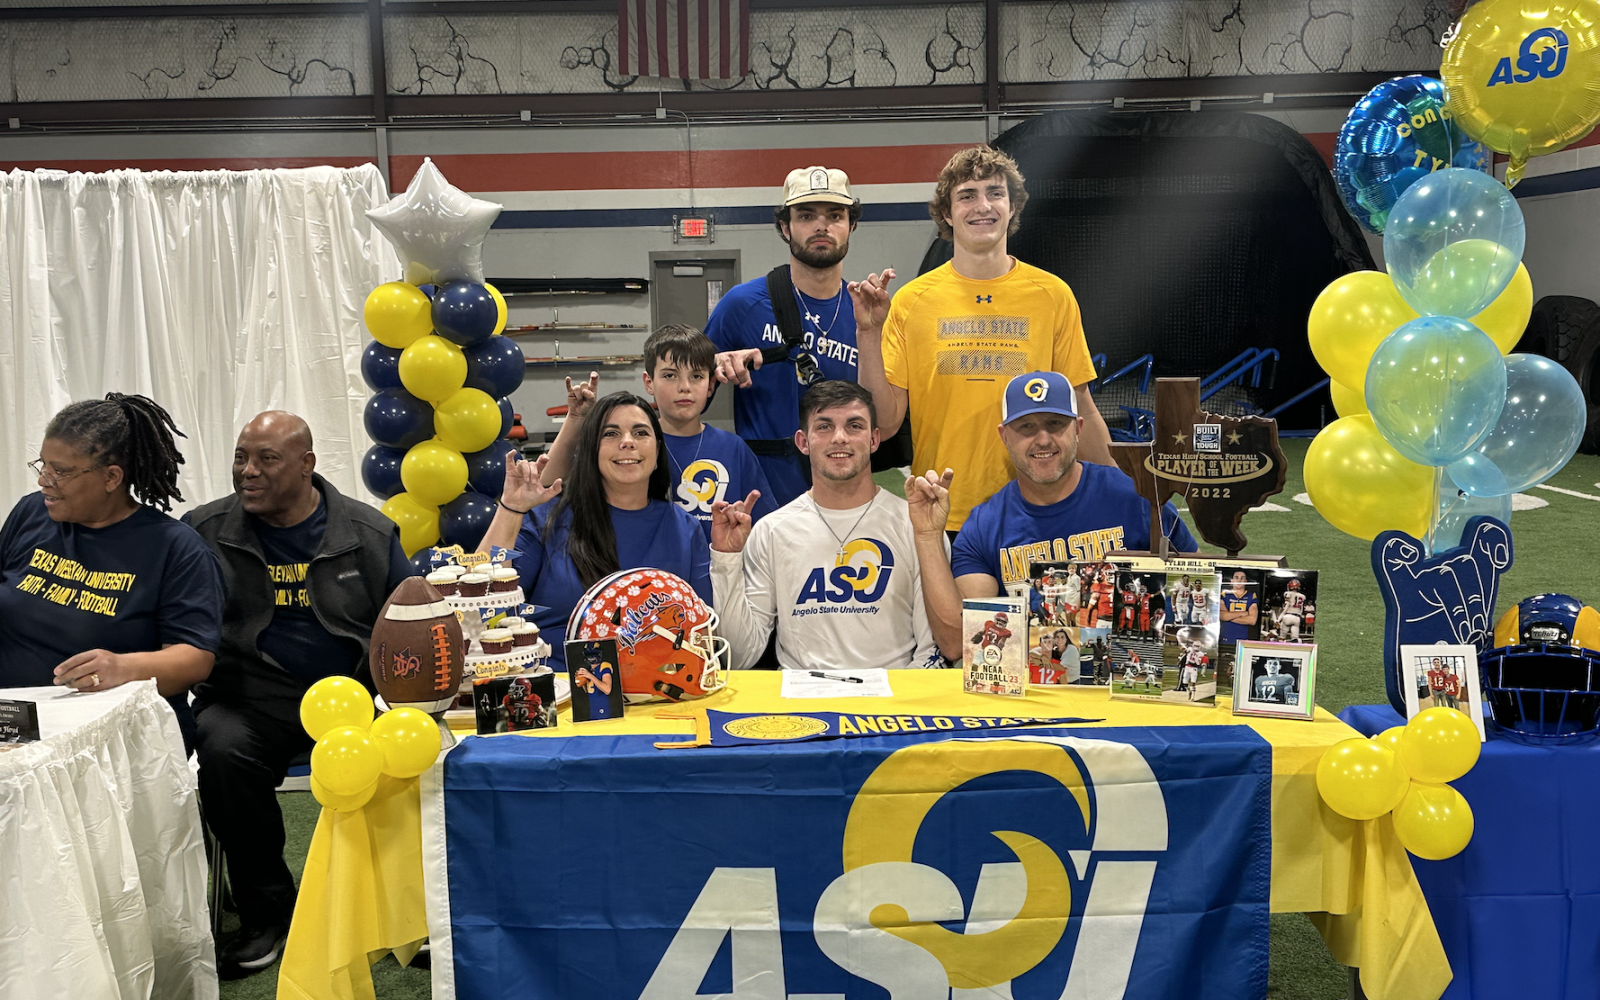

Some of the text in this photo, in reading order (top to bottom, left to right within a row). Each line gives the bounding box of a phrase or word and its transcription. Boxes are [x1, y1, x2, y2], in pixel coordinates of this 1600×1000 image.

[1486, 27, 1569, 87] ASU
[683, 219, 704, 236] EXIT
[941, 318, 1028, 337] ANGELO STATE
[817, 336, 859, 367] STATE
[959, 354, 1003, 371] RAMS
[1196, 426, 1218, 434] BUILT
[1157, 460, 1206, 476] PLAYER
[1209, 460, 1217, 468] OF
[1220, 460, 1260, 476] WEEK
[1191, 488, 1231, 498] 2022
[457, 553, 489, 566] Congrats
[29, 548, 59, 573] TEXAS
[84, 571, 136, 592] UNIVERSITY
[796, 537, 895, 605] ASU
[16, 573, 119, 617] FAITH FAMILY FOOTBALL
[792, 605, 880, 617] Angelo State University
[617, 592, 672, 656] Bobcats
[475, 665, 506, 676] Congrats
[982, 664, 1003, 673] NCAA
[1038, 667, 1056, 684] 12
[970, 671, 1019, 683] FOOTBALL 23
[1433, 677, 1444, 687] 12
[1261, 685, 1276, 700] 12
[514, 707, 530, 722] 12
[839, 715, 955, 735] ANGELO
